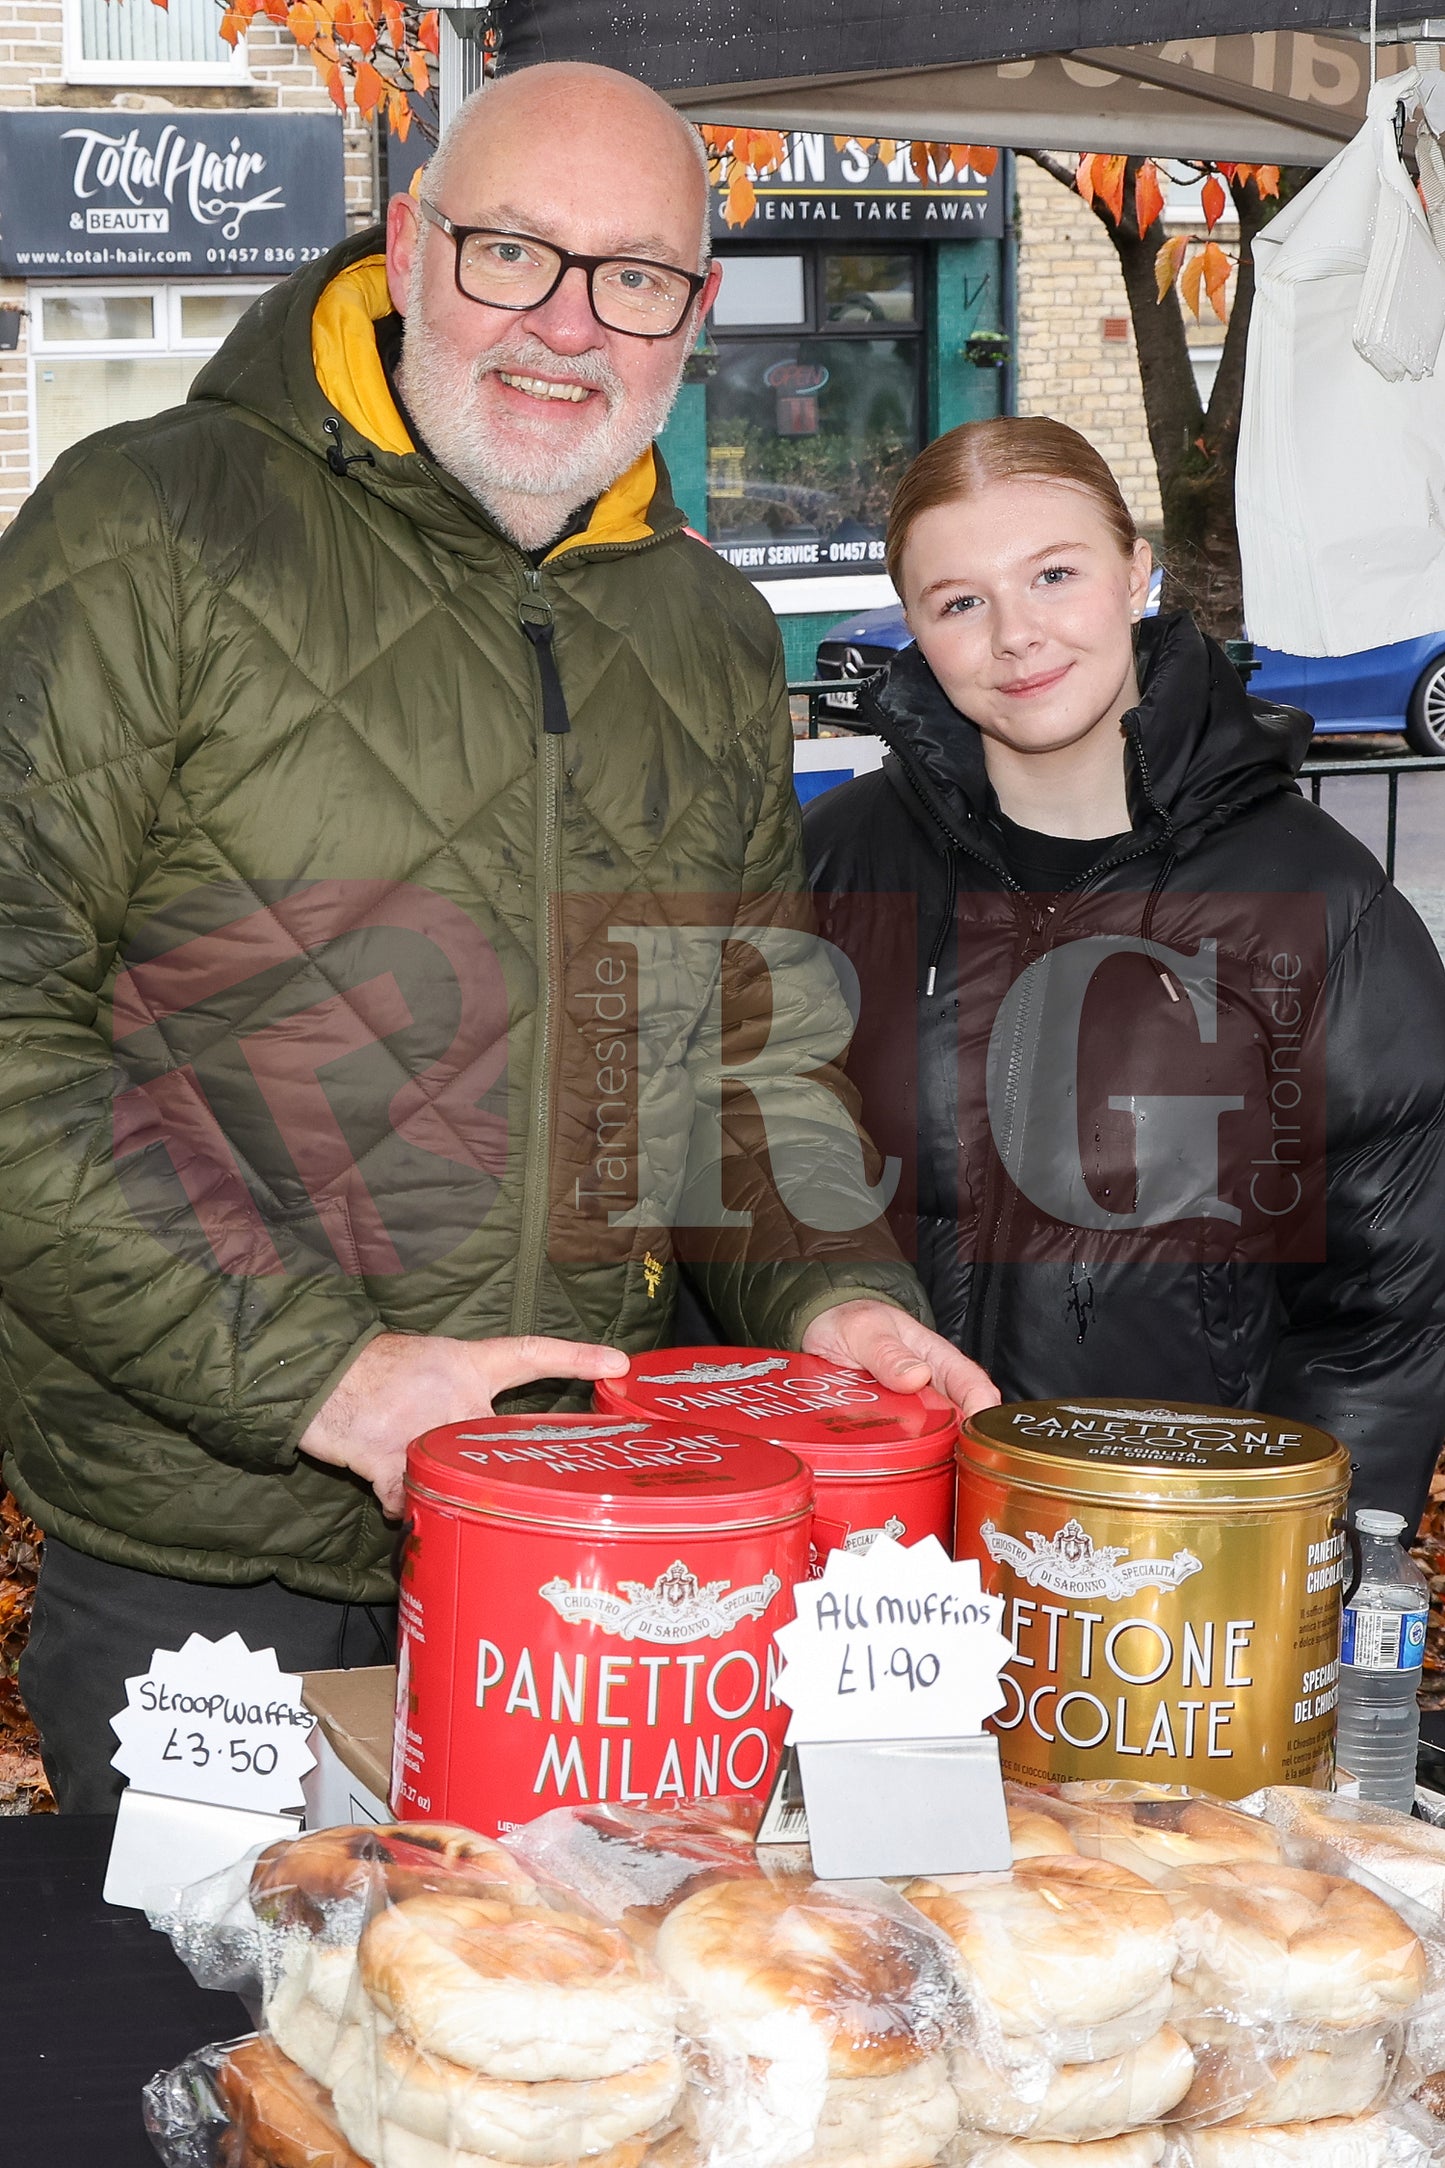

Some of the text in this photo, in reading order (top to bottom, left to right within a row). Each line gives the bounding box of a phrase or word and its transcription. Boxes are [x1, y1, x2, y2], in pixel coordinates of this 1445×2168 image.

[60, 124, 266, 224] Total Hair
[69, 212, 165, 229] & BEAUTY
[854, 202, 911, 220] TAKE
[925, 203, 988, 220] AWAY
[16, 248, 192, 264] www.total-hair.com
[206, 247, 258, 263] 01457
[264, 247, 295, 263] 836
[768, 544, 819, 565] SERVICE
[830, 542, 866, 562] 01457
[869, 541, 886, 560] 83
[655, 1369, 878, 1412] PANETTONE
[737, 1389, 879, 1420] MILANO
[1011, 1413, 1302, 1446] PANETTONE
[1020, 1426, 1286, 1456] CHOCOLATE
[459, 1435, 740, 1464] PANETTONE
[1125, 1452, 1207, 1464] CHIOSTRO
[545, 1452, 722, 1474] MILANO
[991, 1537, 1028, 1562] CHIOSTRO
[1040, 1570, 1107, 1593] DI SARONNO
[563, 1596, 620, 1616] CHIOSTRO
[638, 1617, 710, 1638] DI SARONNO
[838, 1644, 940, 1695] £1.90
[1295, 1699, 1313, 1724] DEL
[162, 1728, 278, 1775] £3.50
[533, 1727, 770, 1800] MILANO
